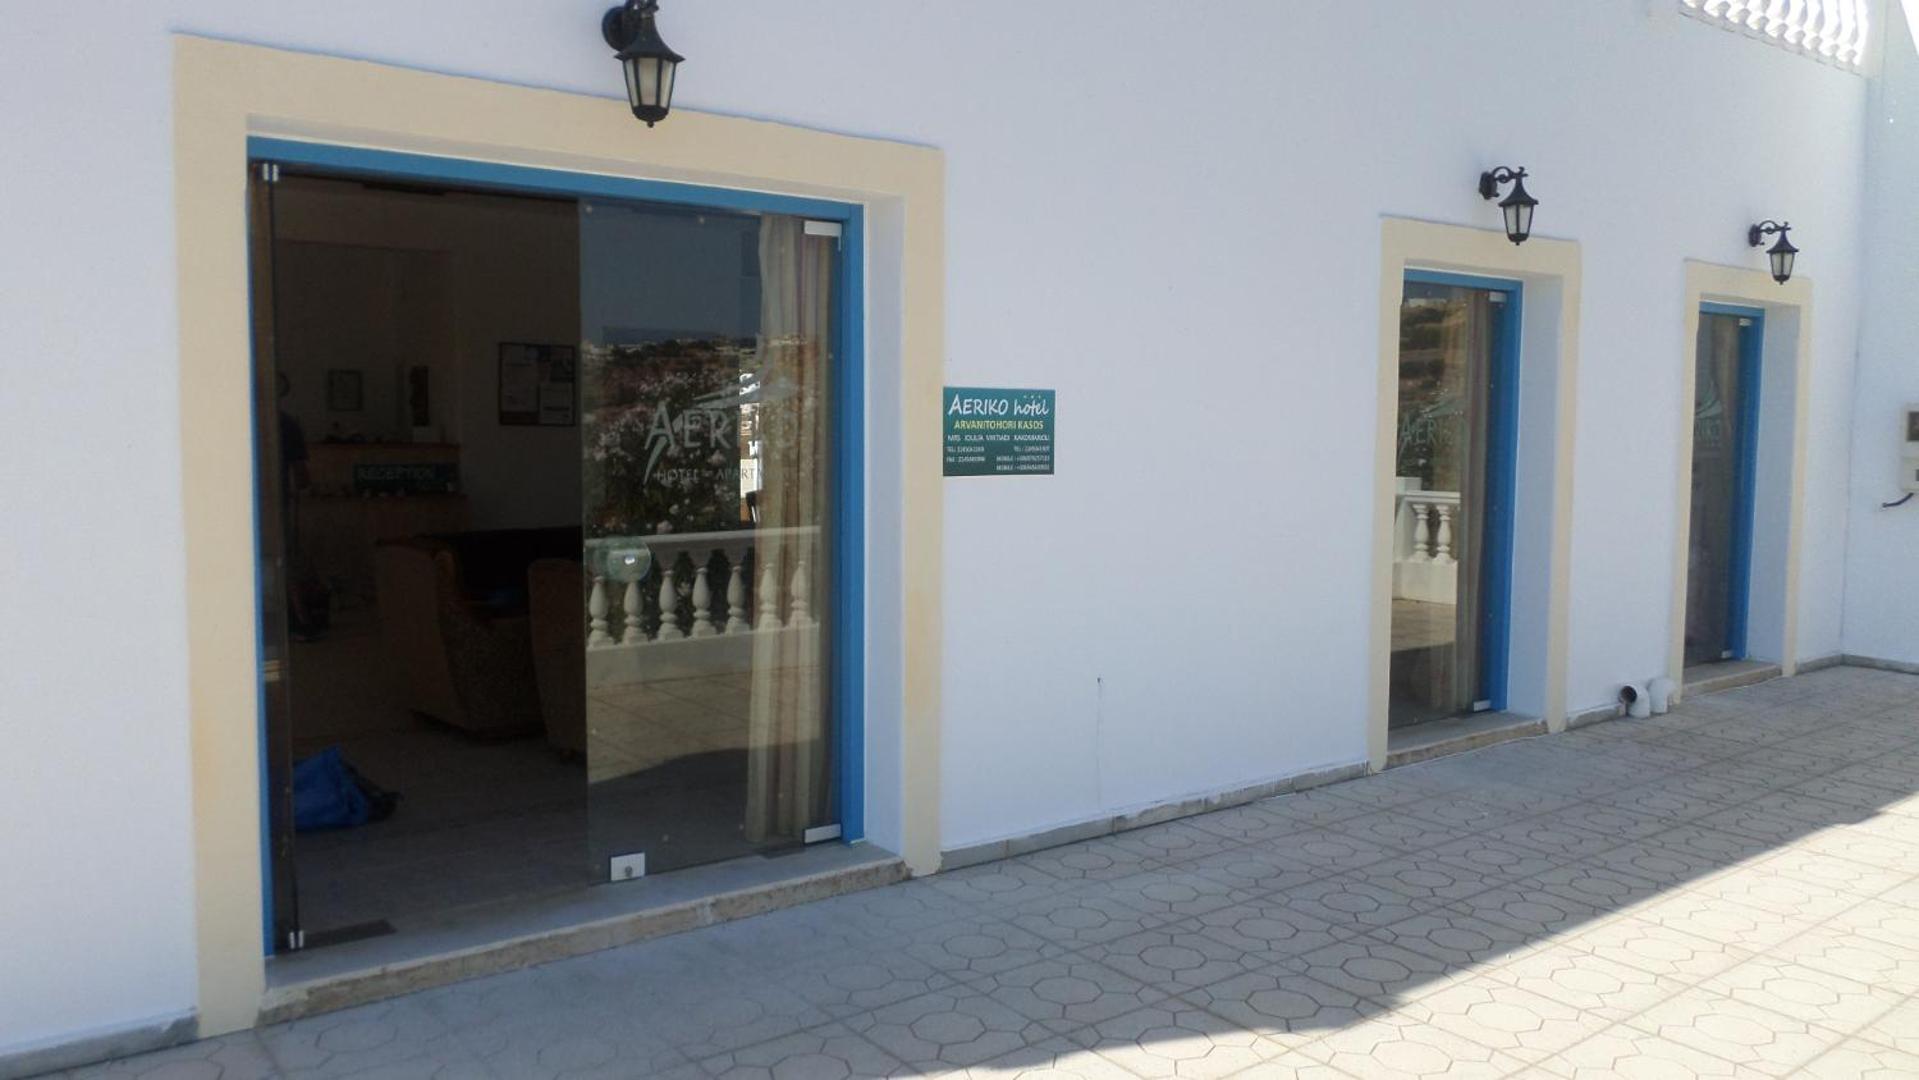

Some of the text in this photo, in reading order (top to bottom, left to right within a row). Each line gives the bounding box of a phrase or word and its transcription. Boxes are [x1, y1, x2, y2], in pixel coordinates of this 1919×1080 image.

[947, 394, 1049, 416] AERIKO hotel
[953, 420, 1044, 430] ARVANITOHORI KASOS
